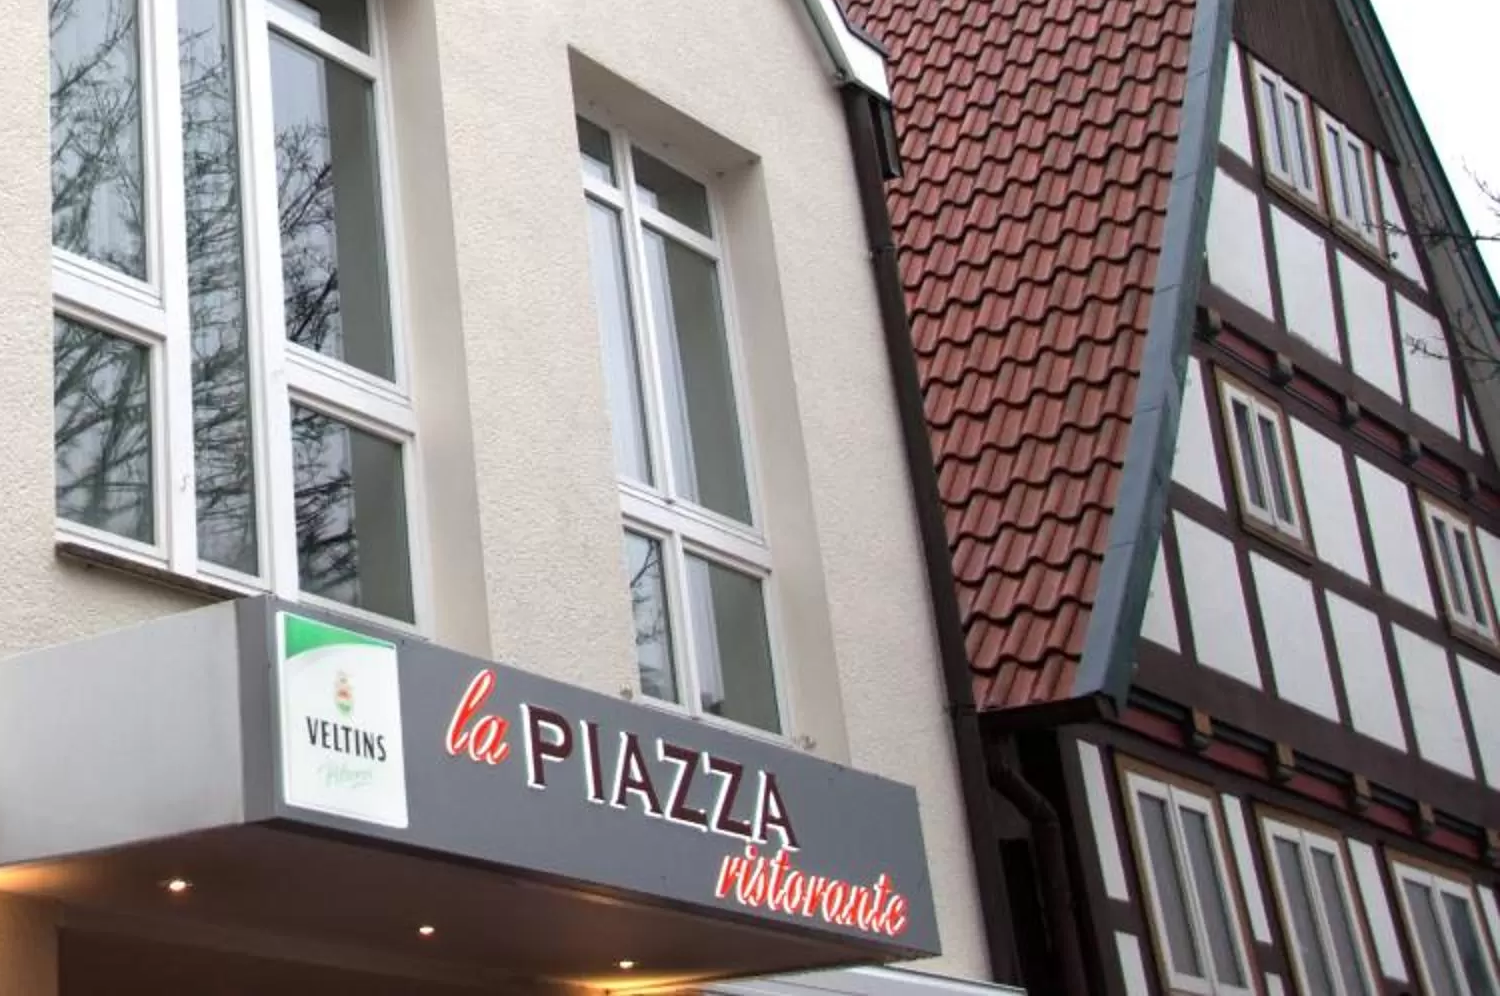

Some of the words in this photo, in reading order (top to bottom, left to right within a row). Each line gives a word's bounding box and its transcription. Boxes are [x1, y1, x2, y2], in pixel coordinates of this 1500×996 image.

[306, 716, 387, 762] VELTINS
[446, 667, 509, 765] la
[520, 703, 800, 851] PIAZZA
[715, 842, 908, 936] ristorante
